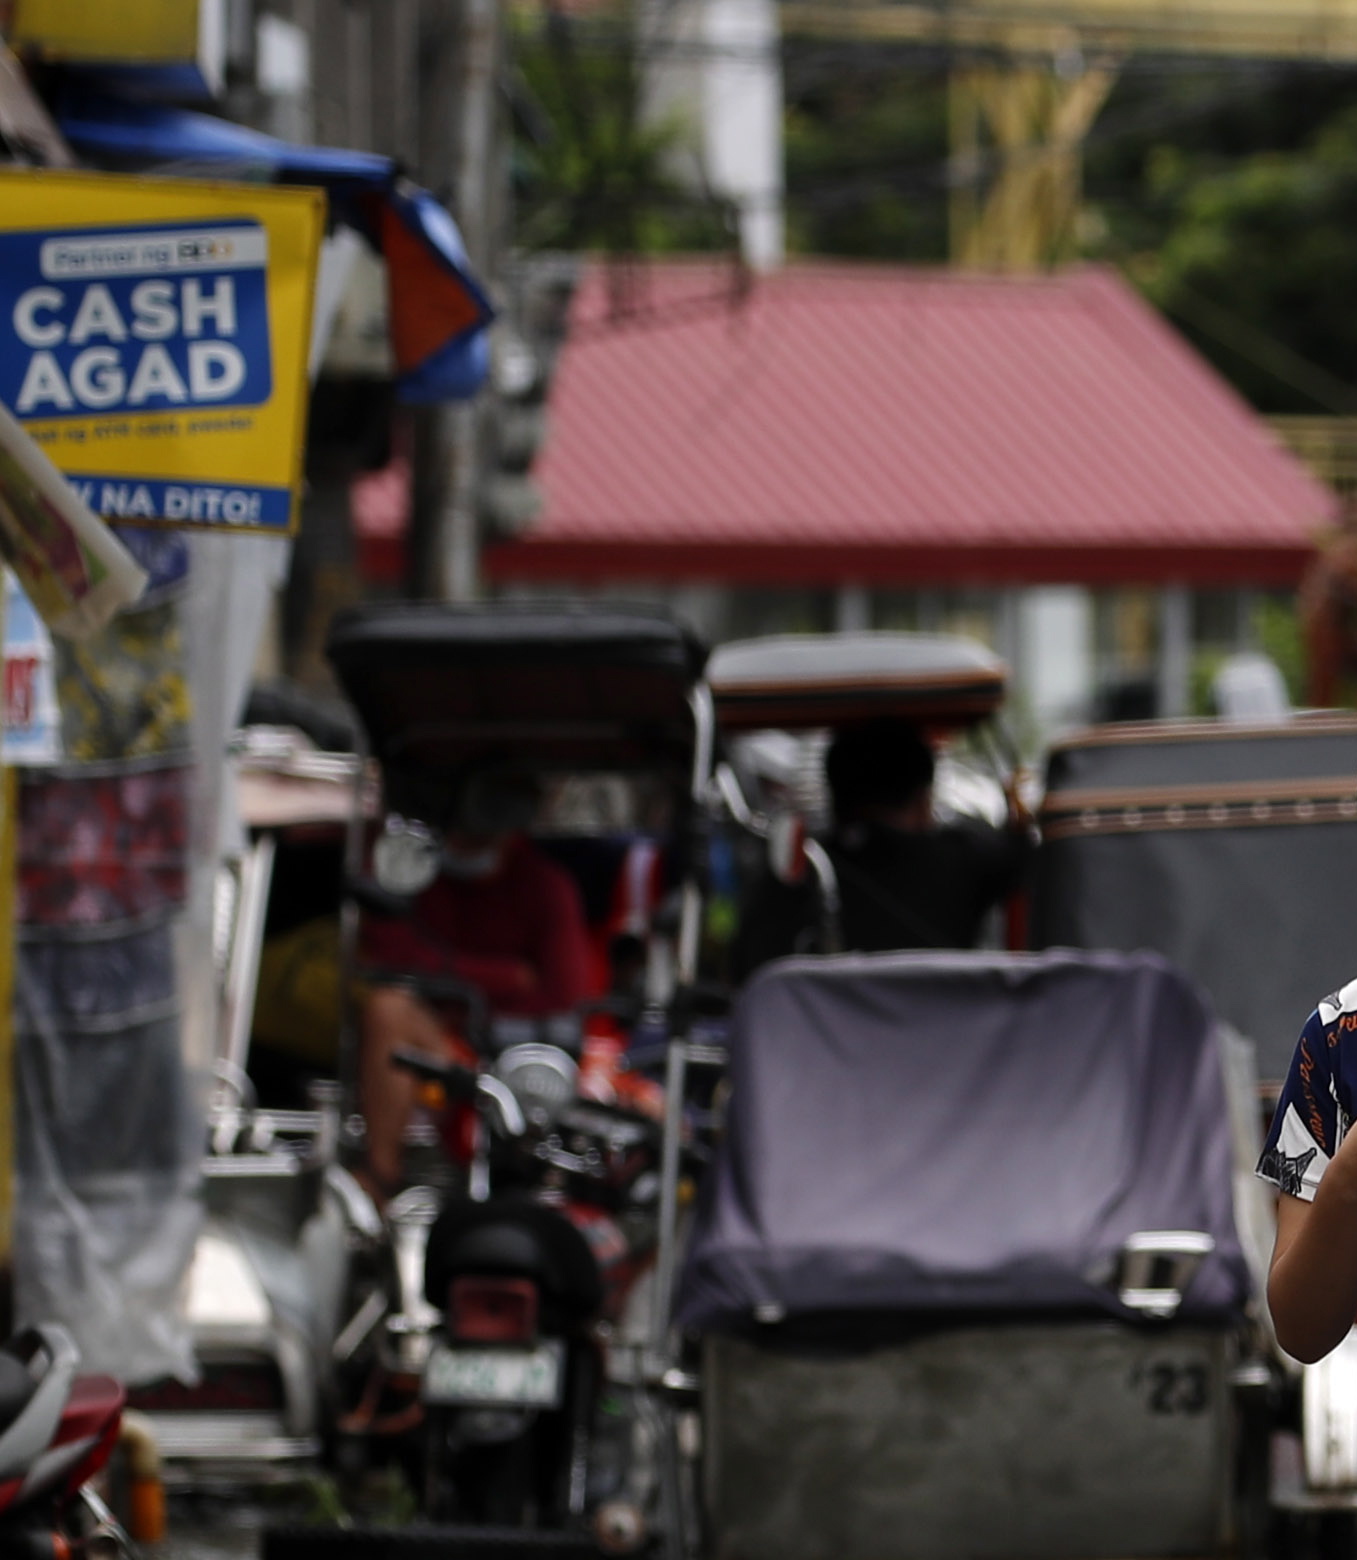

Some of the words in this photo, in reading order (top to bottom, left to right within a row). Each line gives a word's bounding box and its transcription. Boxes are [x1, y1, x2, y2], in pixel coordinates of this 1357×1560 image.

[13, 276, 237, 349] CASH
[15, 340, 246, 414] AGAD
[100, 484, 156, 517] NA
[164, 486, 262, 526] DITO!
